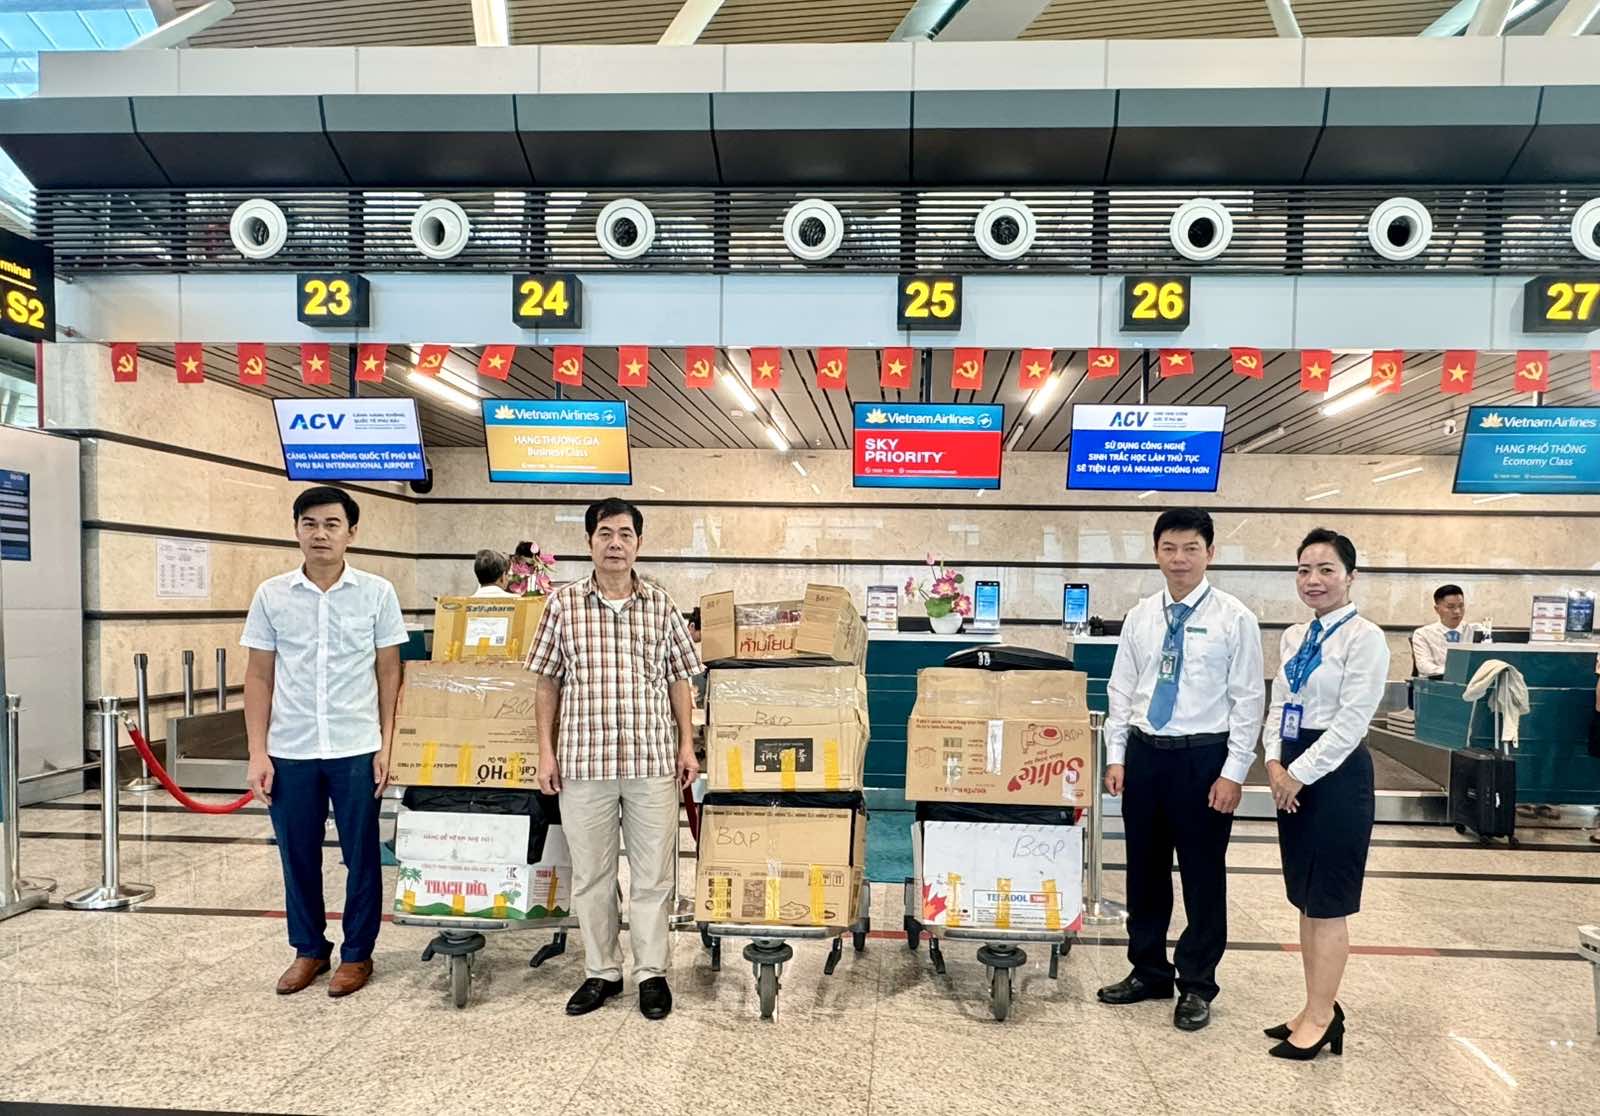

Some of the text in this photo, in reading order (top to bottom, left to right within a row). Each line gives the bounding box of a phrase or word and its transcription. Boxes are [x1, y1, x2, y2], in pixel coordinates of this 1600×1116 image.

[6, 290, 45, 330] S2
[304, 279, 351, 316] 23
[519, 280, 568, 317] 24
[904, 281, 956, 318] 25
[1131, 282, 1184, 319] 26
[1546, 282, 1600, 320] 27
[289, 413, 346, 430] ACV
[1109, 411, 1150, 427] ACV
[865, 438, 899, 450] SKY
[865, 451, 943, 463] PRIORITY
[1502, 456, 1574, 467] Economy Class
[518, 765, 537, 777] Caf
[1019, 756, 1085, 787] Solite
[1012, 834, 1065, 863] BQP
[424, 880, 463, 897] THẠCH
